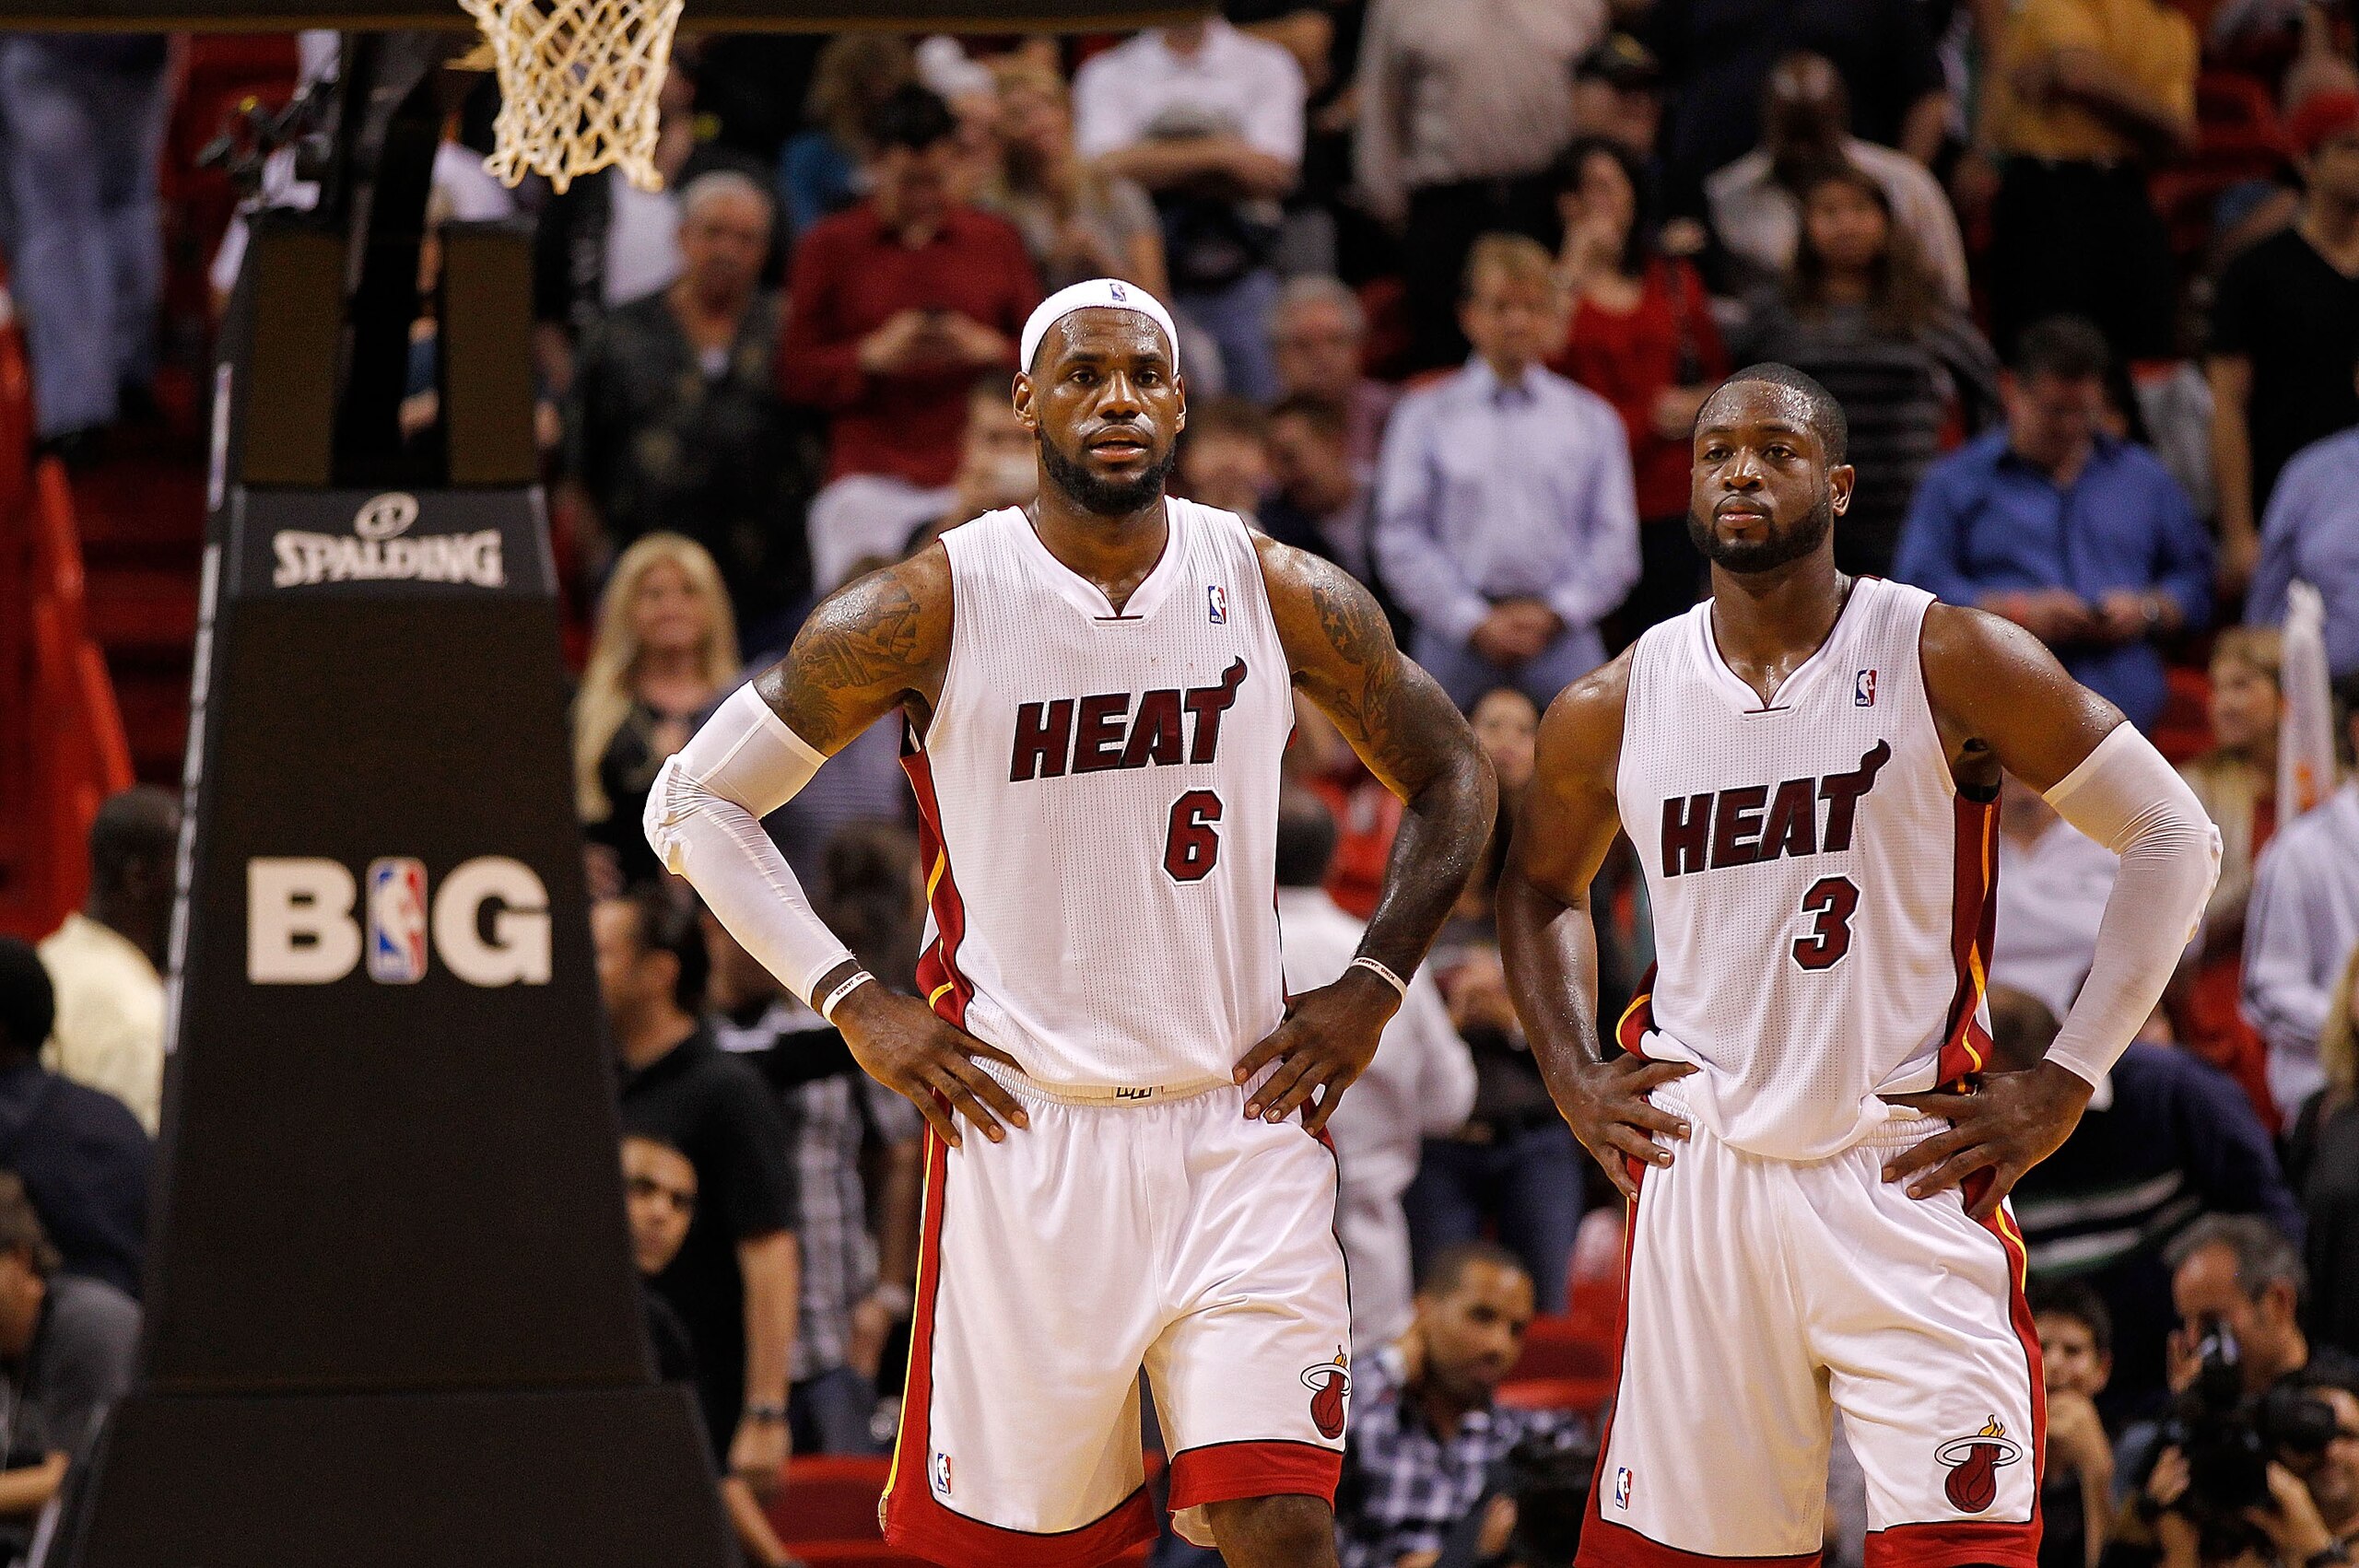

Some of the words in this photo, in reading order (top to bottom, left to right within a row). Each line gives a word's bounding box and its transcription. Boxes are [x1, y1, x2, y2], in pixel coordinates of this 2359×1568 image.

[273, 529, 504, 589] SPALDING
[1010, 655, 1248, 782] HEAT
[1162, 788, 1224, 884] 6
[1661, 738, 1891, 878] HEAT
[1791, 874, 1861, 971] 3
